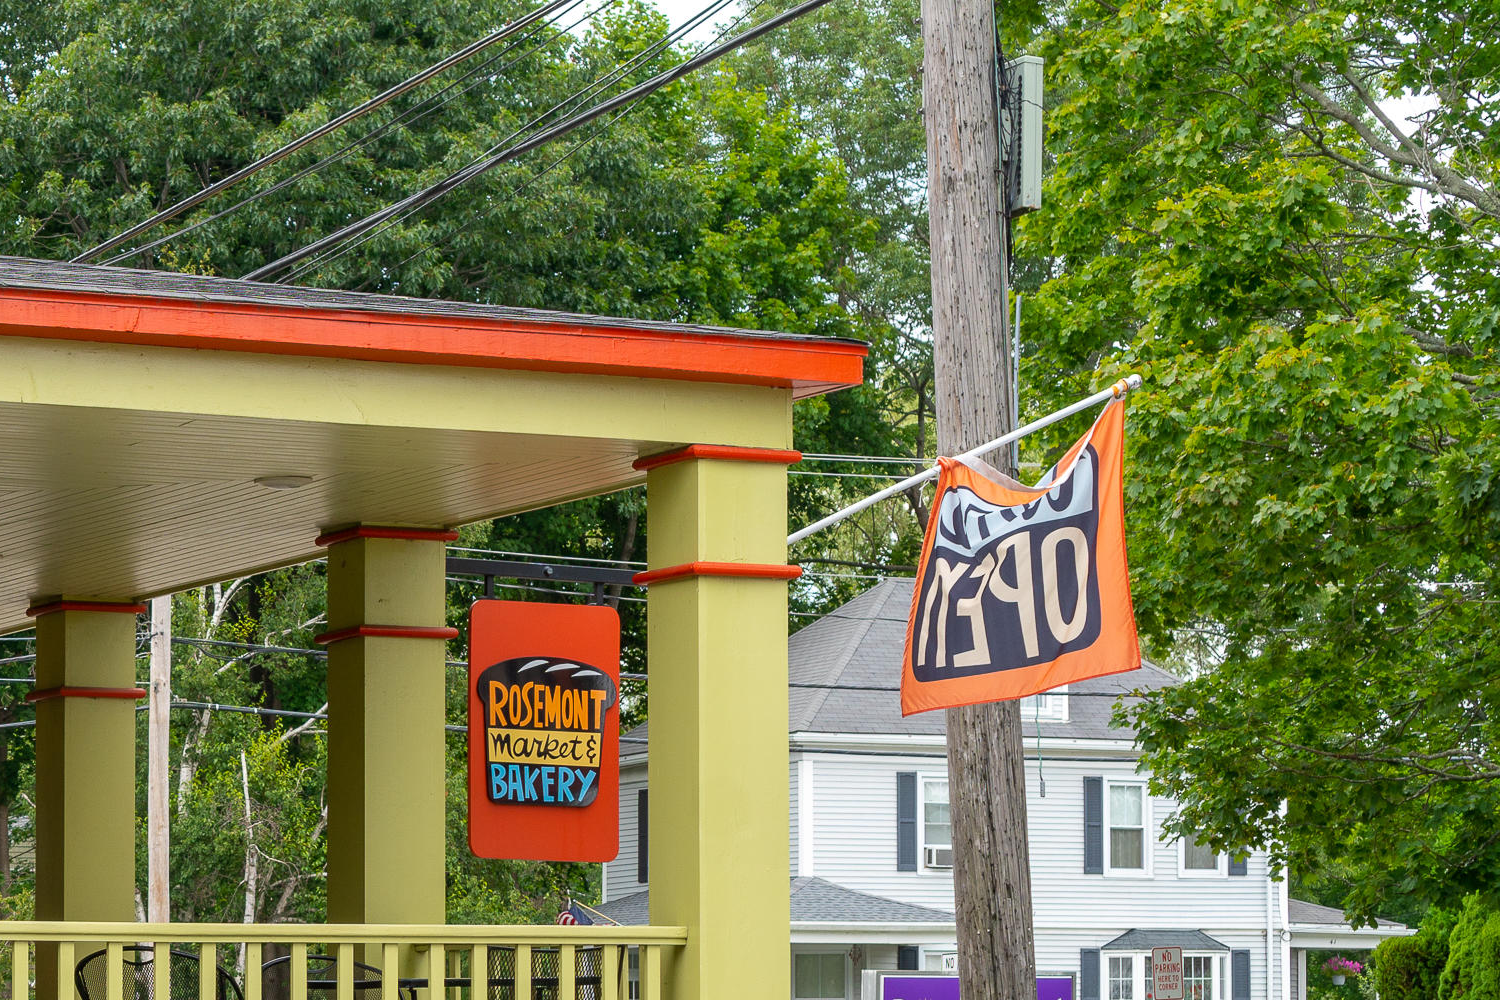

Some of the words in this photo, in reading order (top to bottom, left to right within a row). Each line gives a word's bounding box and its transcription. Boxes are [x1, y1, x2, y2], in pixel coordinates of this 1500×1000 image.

[489, 680, 607, 730] ROSEMONT
[490, 732, 583, 761] Market
[586, 735, 597, 764] &
[490, 763, 597, 803] BAKERY
[1162, 951, 1172, 962] NO
[945, 957, 955, 969] NO
[1155, 963, 1181, 973] PARKING
[1158, 983, 1179, 991] CORNER
